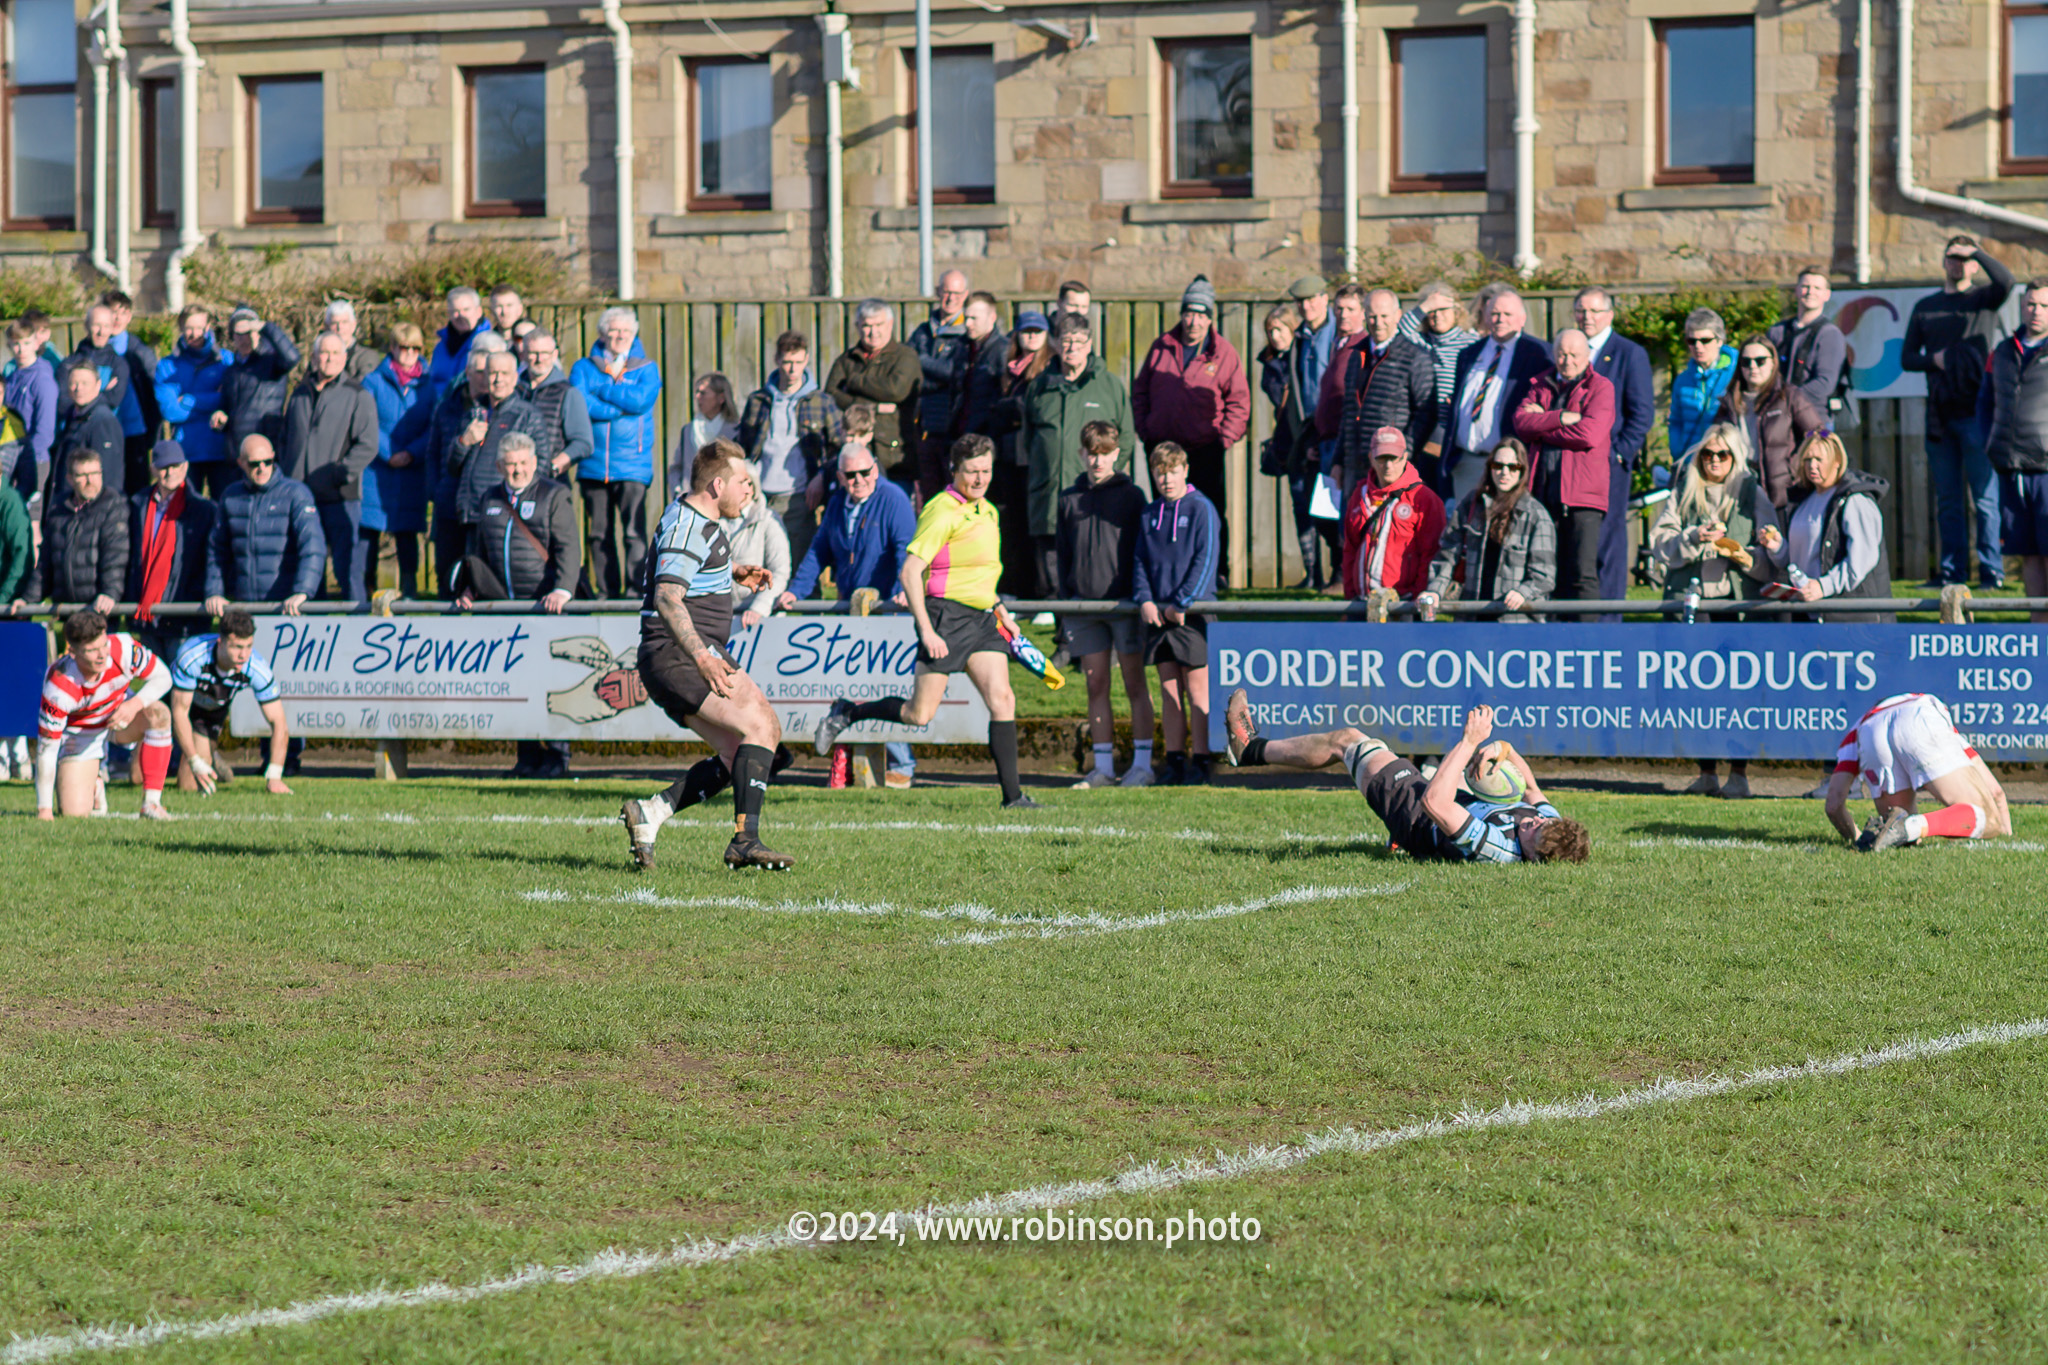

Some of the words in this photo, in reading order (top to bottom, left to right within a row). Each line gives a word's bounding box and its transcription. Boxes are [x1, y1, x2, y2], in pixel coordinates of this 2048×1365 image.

[269, 622, 341, 672] Phil
[353, 622, 530, 675] Stewart
[777, 623, 918, 676] Stewa
[1909, 635, 2038, 660] JEDBURGH
[1220, 649, 1385, 688] BORDER
[1399, 650, 1621, 688] CONCRETE
[1639, 651, 1876, 690] PRODUCTS
[1959, 669, 2032, 690] KELSO
[279, 681, 339, 695] BUILDING
[343, 682, 350, 694] &
[355, 682, 414, 695] ROOFING
[418, 681, 510, 695] CONTRACTOR
[766, 684, 774, 697] &
[779, 683, 846, 699] ROOFING
[850, 683, 950, 699] CONTRA
[297, 712, 345, 728] KELSO
[388, 713, 438, 732] (01573)
[443, 714, 493, 729] 225167
[1247, 703, 1336, 726] PRECAST
[1343, 704, 1462, 727] CONCRETE
[1493, 706, 1549, 727] CAST
[1557, 706, 1631, 728] STONE
[1640, 708, 1847, 730] MANUFACTURERS
[1950, 703, 2004, 725] 1573
